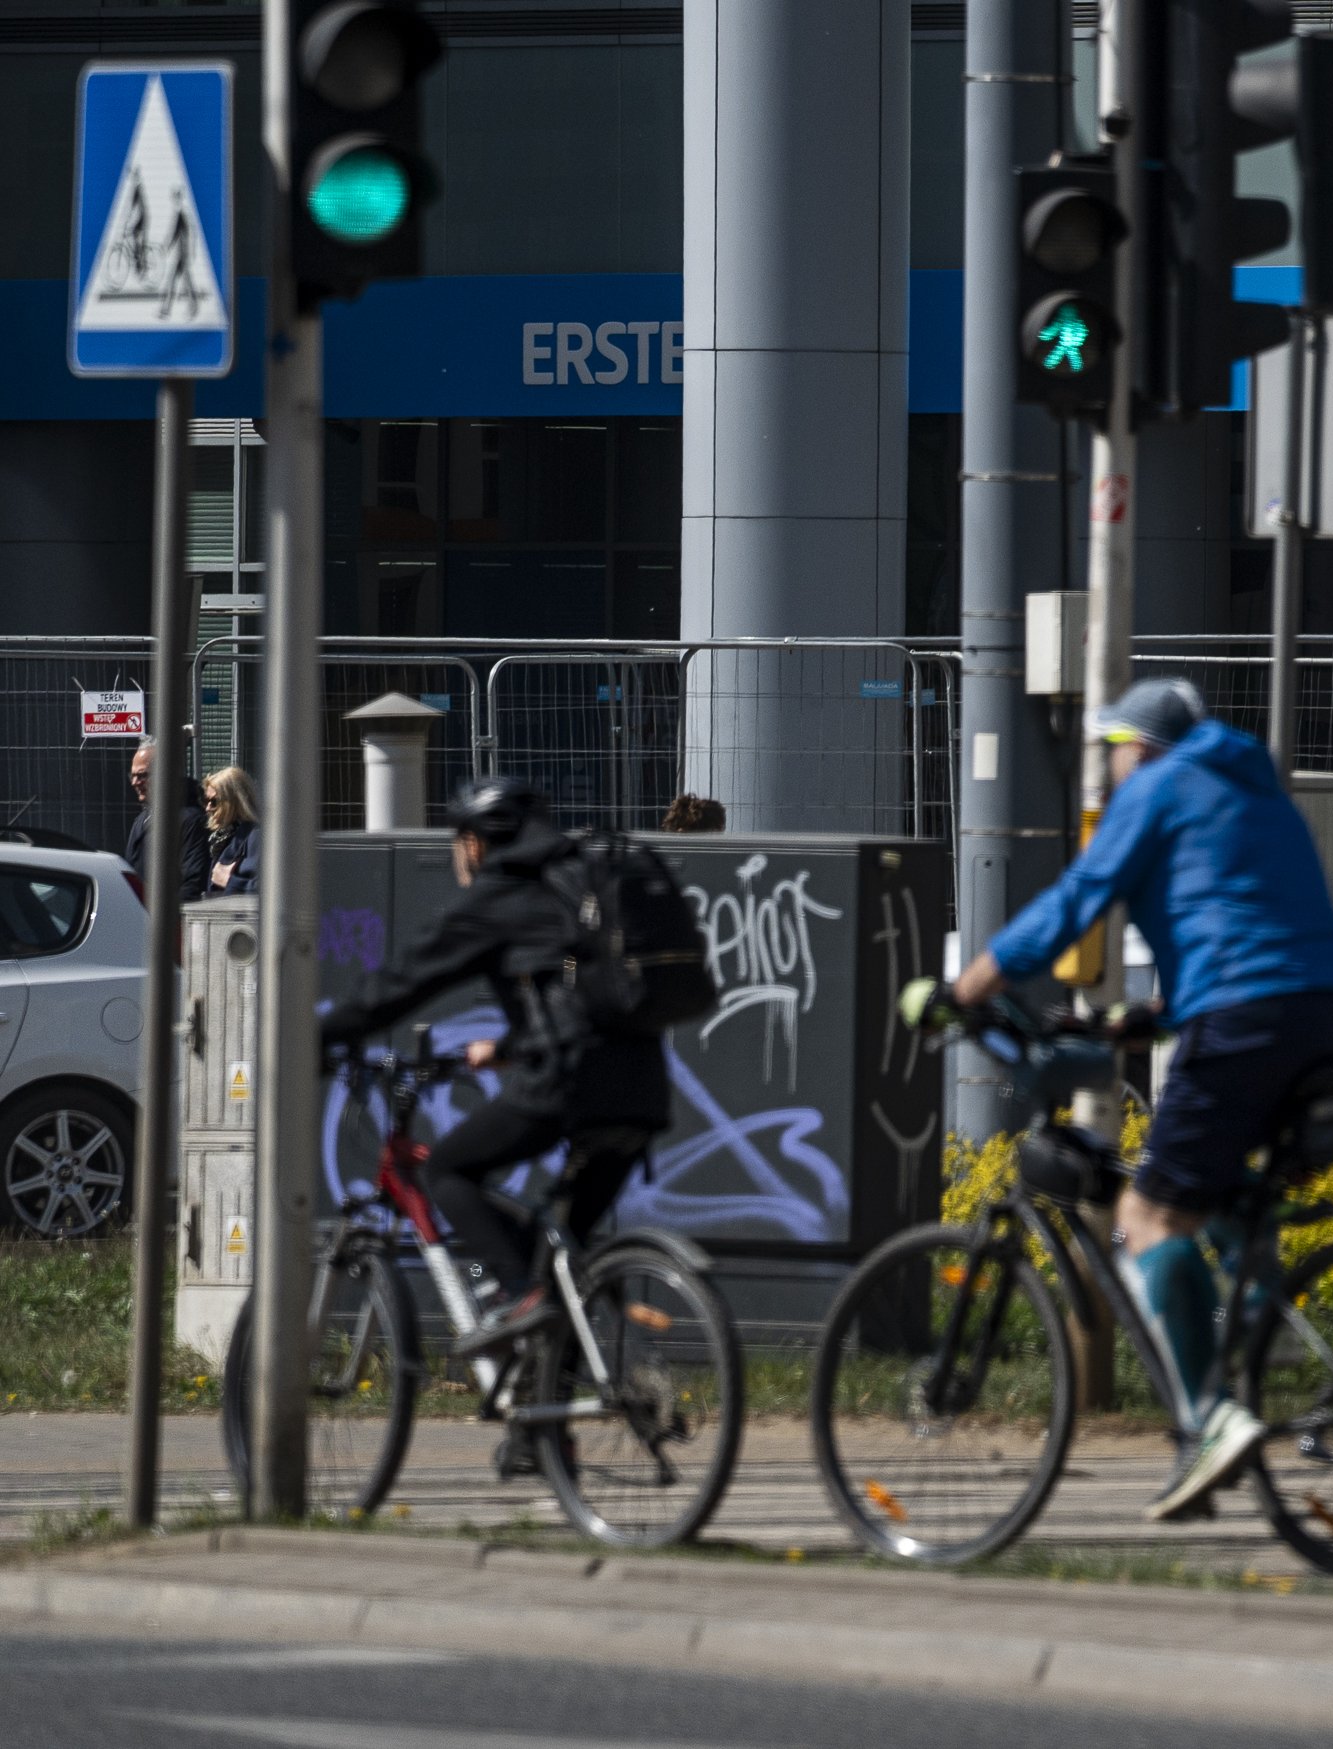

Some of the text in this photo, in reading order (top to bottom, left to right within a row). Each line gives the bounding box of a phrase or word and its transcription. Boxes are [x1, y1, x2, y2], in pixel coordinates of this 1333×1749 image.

[523, 322, 684, 385] ERSTE
[100, 693, 124, 702] TEREN
[97, 703, 128, 712] BUDOWY
